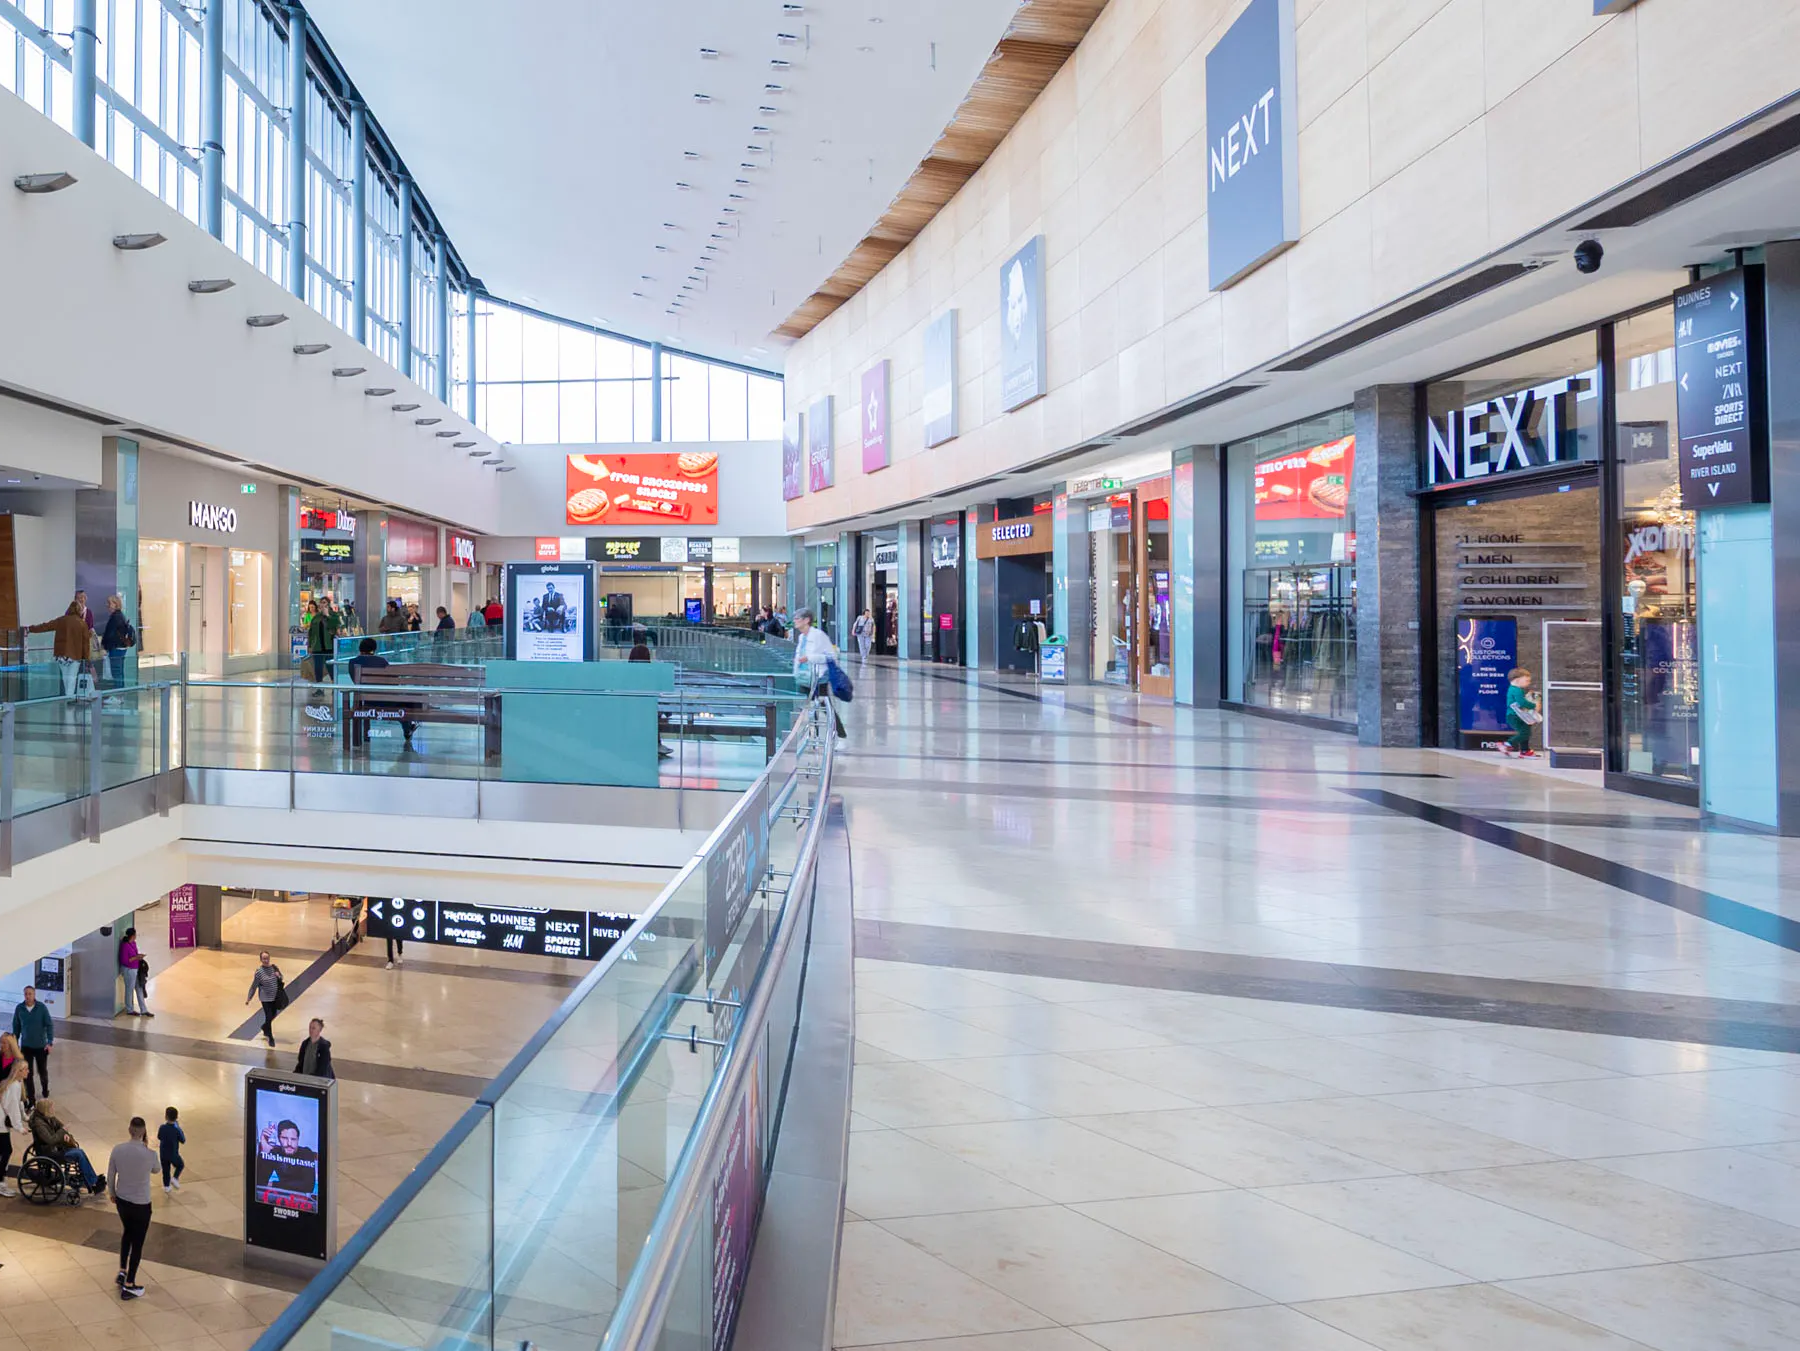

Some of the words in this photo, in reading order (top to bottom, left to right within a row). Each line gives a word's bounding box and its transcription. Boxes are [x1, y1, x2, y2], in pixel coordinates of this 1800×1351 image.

[1211, 86, 1275, 193] NEXT
[1677, 286, 1711, 308] DUNNES
[1715, 361, 1742, 379] NEXT
[1714, 400, 1744, 416] SPORTS
[1714, 411, 1744, 426] DIRECT
[1428, 380, 1568, 485] NEXT
[1692, 439, 1734, 460] SuperValu
[1690, 466, 1709, 479] RIVER
[1711, 463, 1736, 477] ISLAND
[609, 471, 640, 485] from
[642, 477, 708, 494] snoozefest
[636, 486, 678, 500] snacks
[191, 500, 237, 533] MANGO
[337, 508, 356, 538] Dubray
[992, 523, 1032, 541] SELECTED
[1478, 534, 1525, 544] HOME
[1478, 555, 1513, 564] MEN
[541, 565, 559, 573] global
[1463, 576, 1474, 585] G
[1479, 575, 1560, 585] CHILDREN
[1463, 596, 1475, 605] G
[1480, 596, 1543, 605] WOMEN
[726, 828, 747, 902] ZERO
[172, 903, 194, 912] PRICE
[173, 896, 193, 904] HALF
[490, 913, 536, 927] DUNNES
[545, 921, 580, 934] NEXT
[592, 927, 620, 939] RIVER
[503, 933, 524, 950] H&M
[544, 935, 581, 947] SPORTS
[545, 945, 581, 956] DIRECT
[261, 1151, 276, 1160] This
[277, 1153, 283, 1161] is
[283, 1155, 296, 1166] my
[297, 1157, 315, 1168] taste
[273, 1207, 299, 1217] SWORDS
